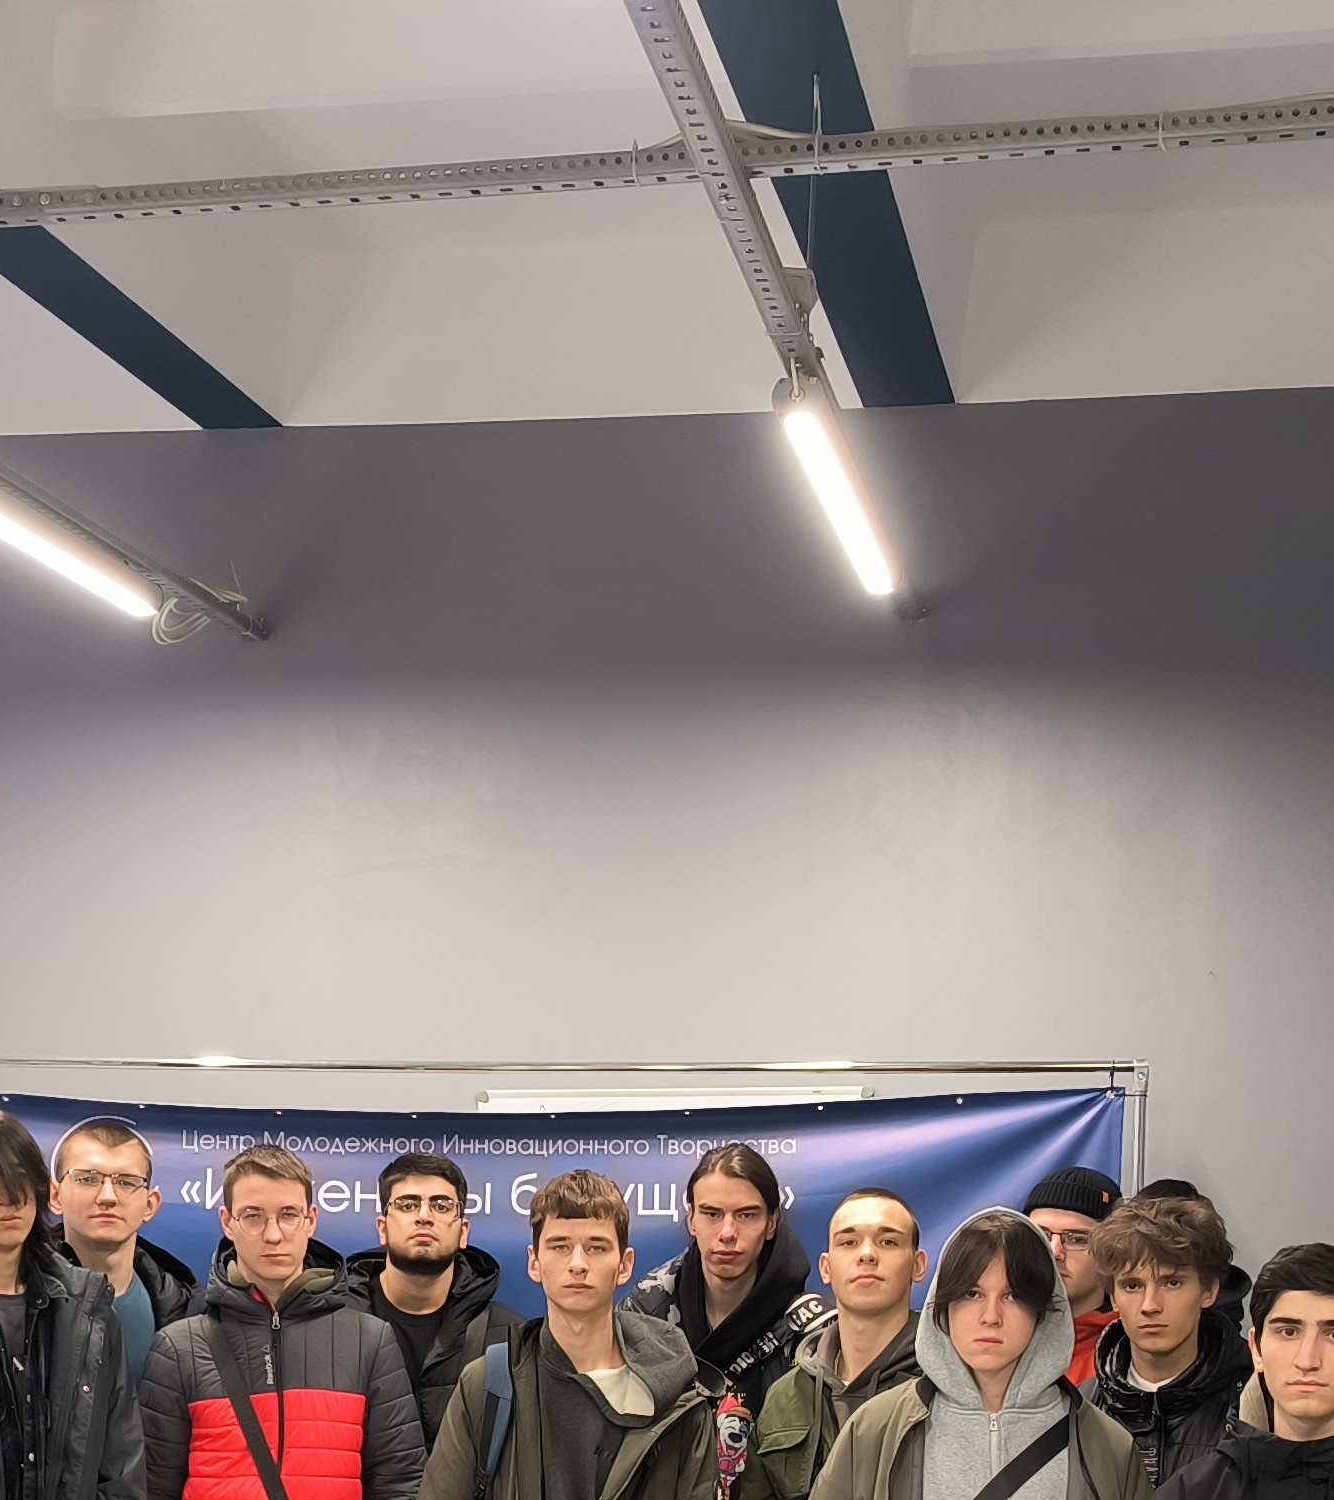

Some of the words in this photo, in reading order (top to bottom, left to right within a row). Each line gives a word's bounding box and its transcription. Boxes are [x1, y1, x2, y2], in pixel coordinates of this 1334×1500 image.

[181, 1129, 255, 1153] Центр
[263, 1131, 435, 1155] Молодежного
[443, 1134, 650, 1157] Инновационного
